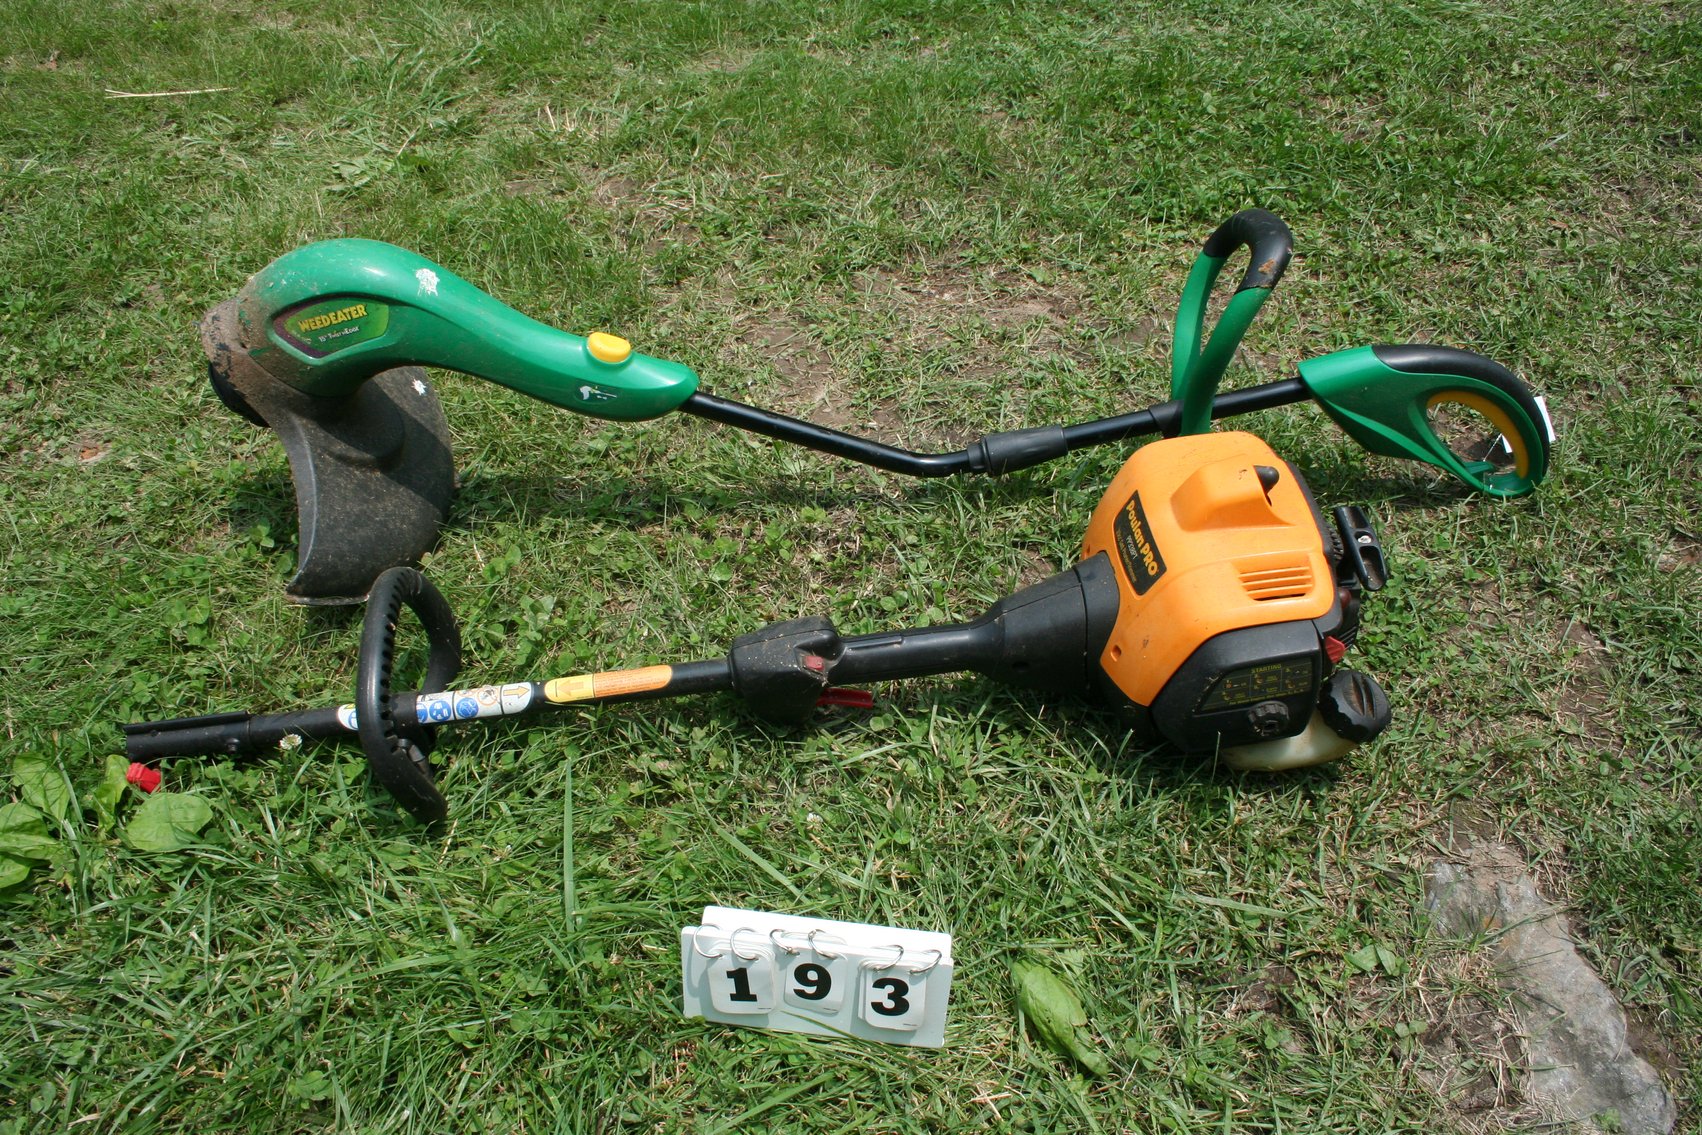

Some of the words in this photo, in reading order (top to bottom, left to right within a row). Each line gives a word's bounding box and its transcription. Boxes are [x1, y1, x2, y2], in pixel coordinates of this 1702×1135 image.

[299, 304, 367, 332] WEEDEATER
[1140, 542, 1158, 576] PRO
[1252, 664, 1281, 674] STARTING
